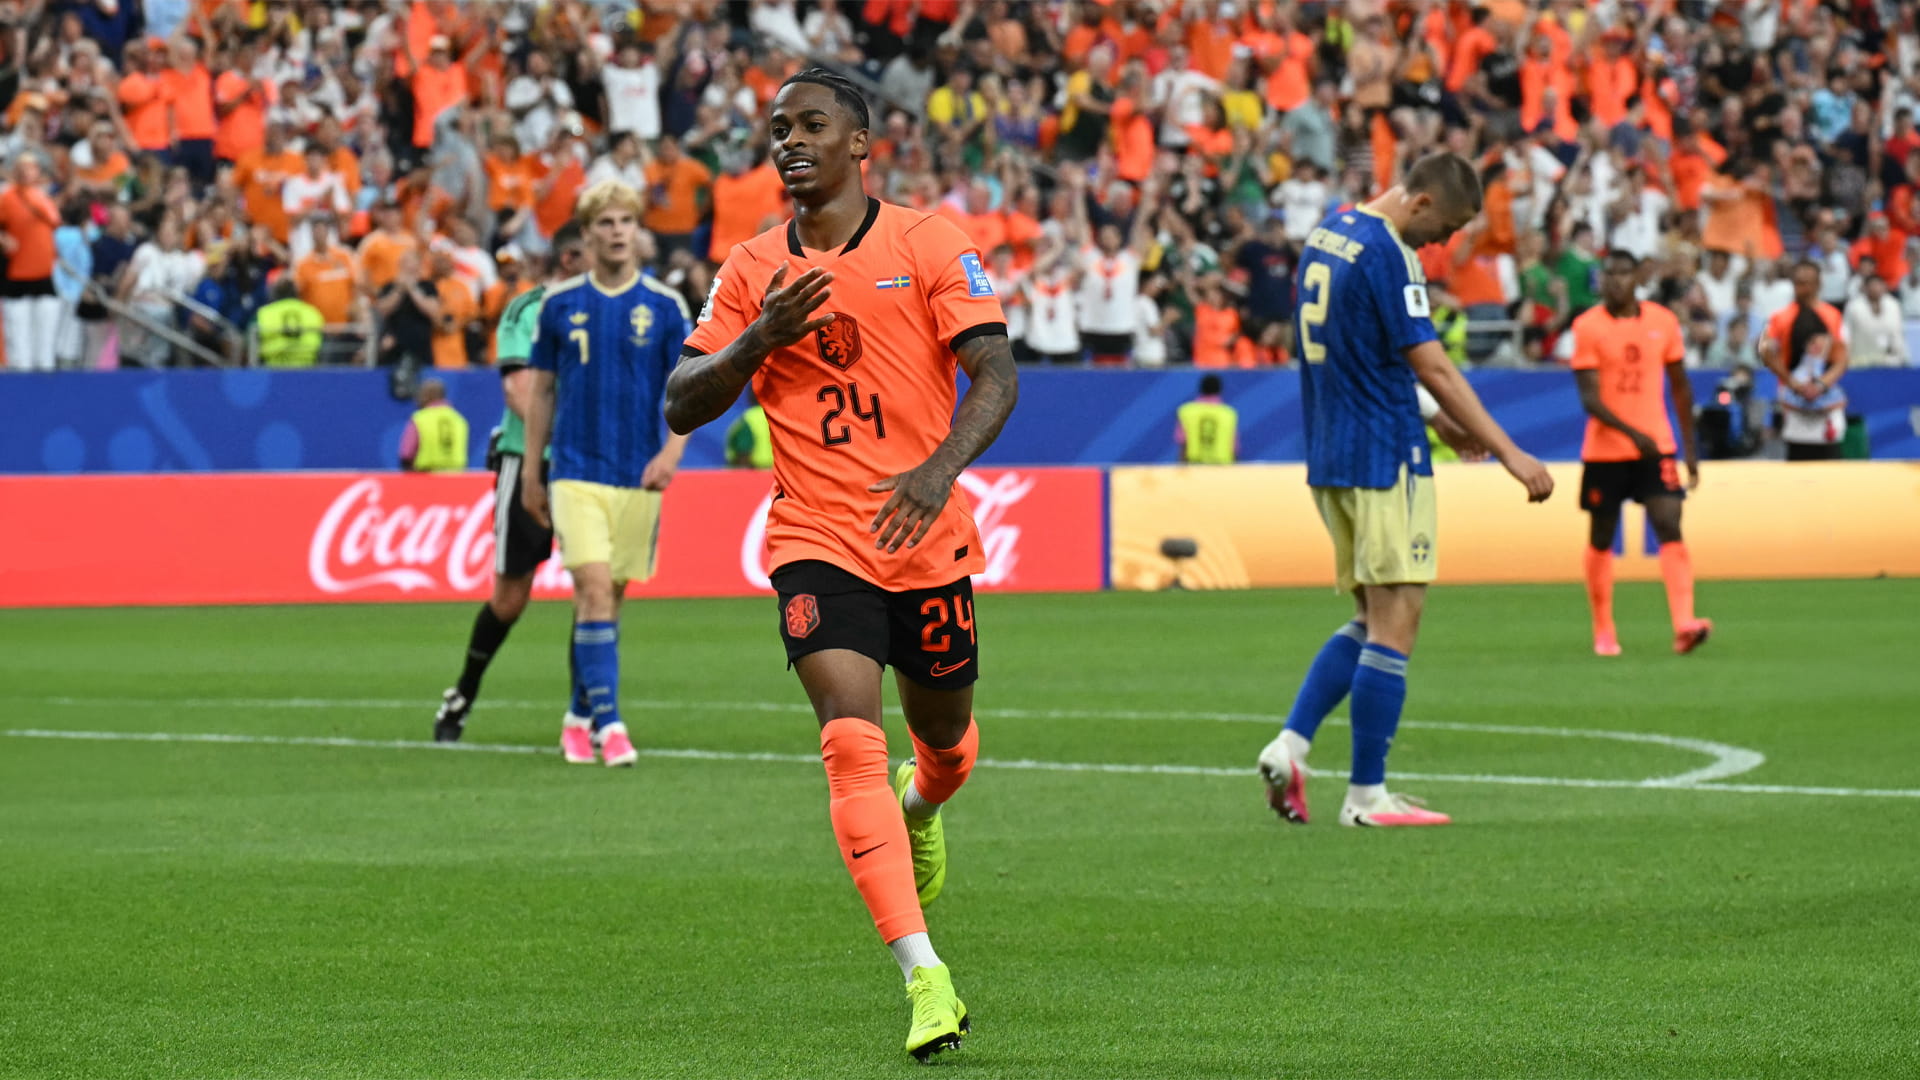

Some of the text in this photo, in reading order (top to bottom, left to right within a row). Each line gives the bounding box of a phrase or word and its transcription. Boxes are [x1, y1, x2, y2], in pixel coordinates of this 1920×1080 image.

[1300, 262, 1331, 365] 2
[568, 327, 589, 365] 7
[816, 382, 886, 447] 24
[919, 594, 976, 653] 24
